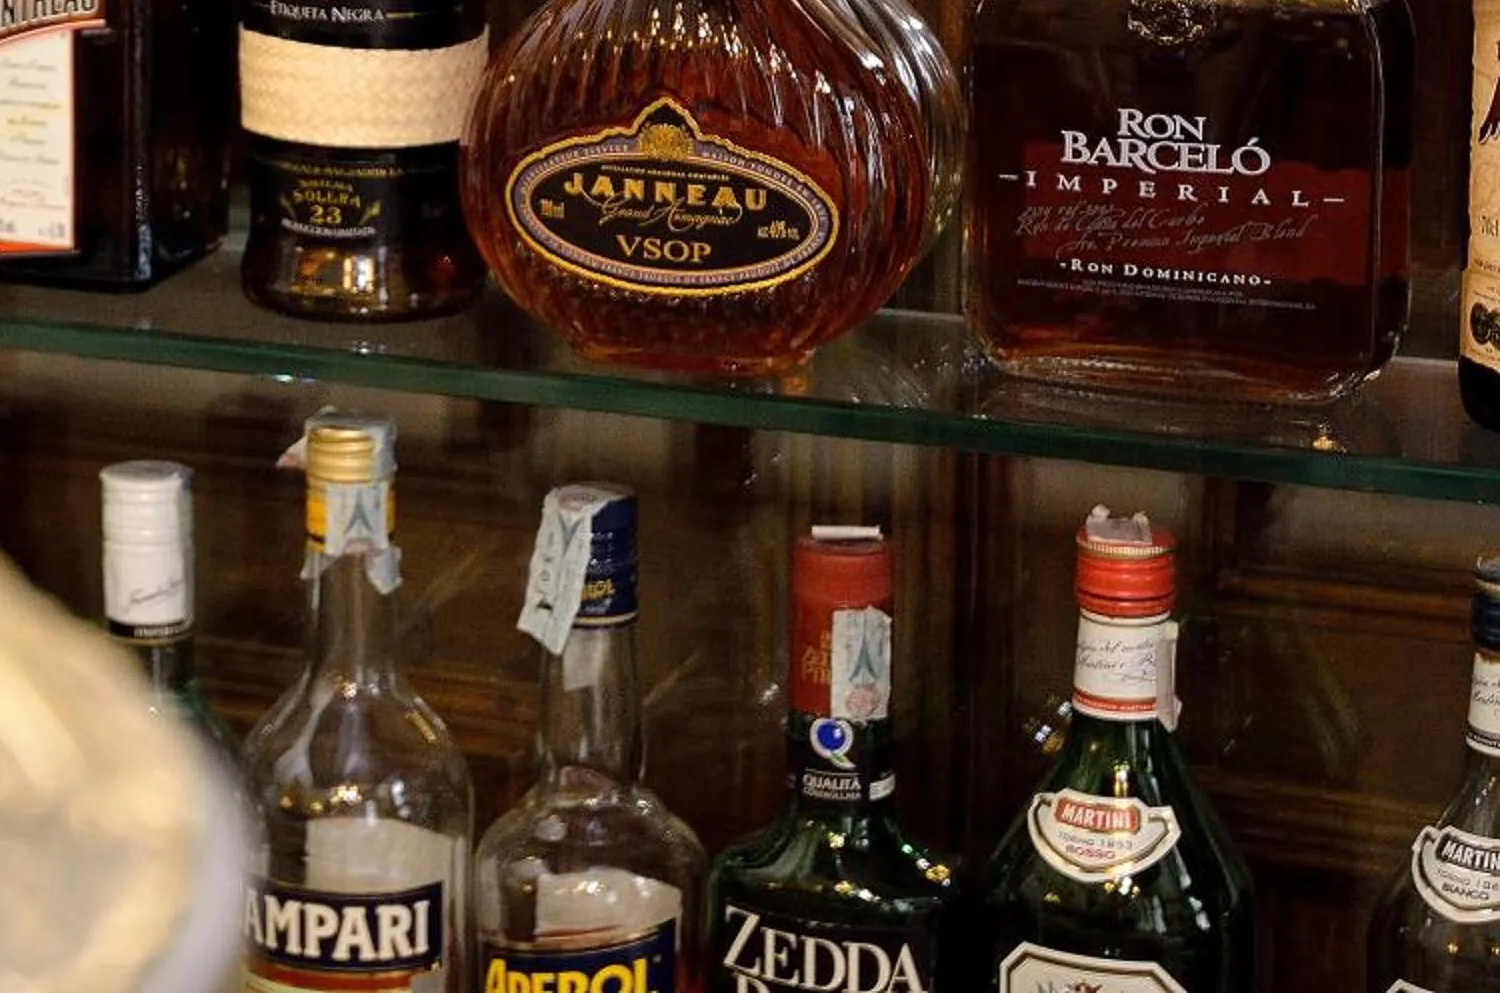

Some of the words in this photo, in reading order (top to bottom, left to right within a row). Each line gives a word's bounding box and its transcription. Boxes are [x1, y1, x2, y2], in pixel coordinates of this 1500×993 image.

[1117, 108, 1207, 140] RON
[1060, 129, 1272, 176] BARCELÓ
[564, 173, 768, 212] JANNEAU
[309, 205, 342, 225] 23
[615, 234, 712, 264] VSOP
[1060, 802, 1132, 828] MARTINI
[1442, 840, 1500, 870] MARTIN
[243, 886, 430, 961] AMPARI
[723, 904, 930, 993] ZEDDA
